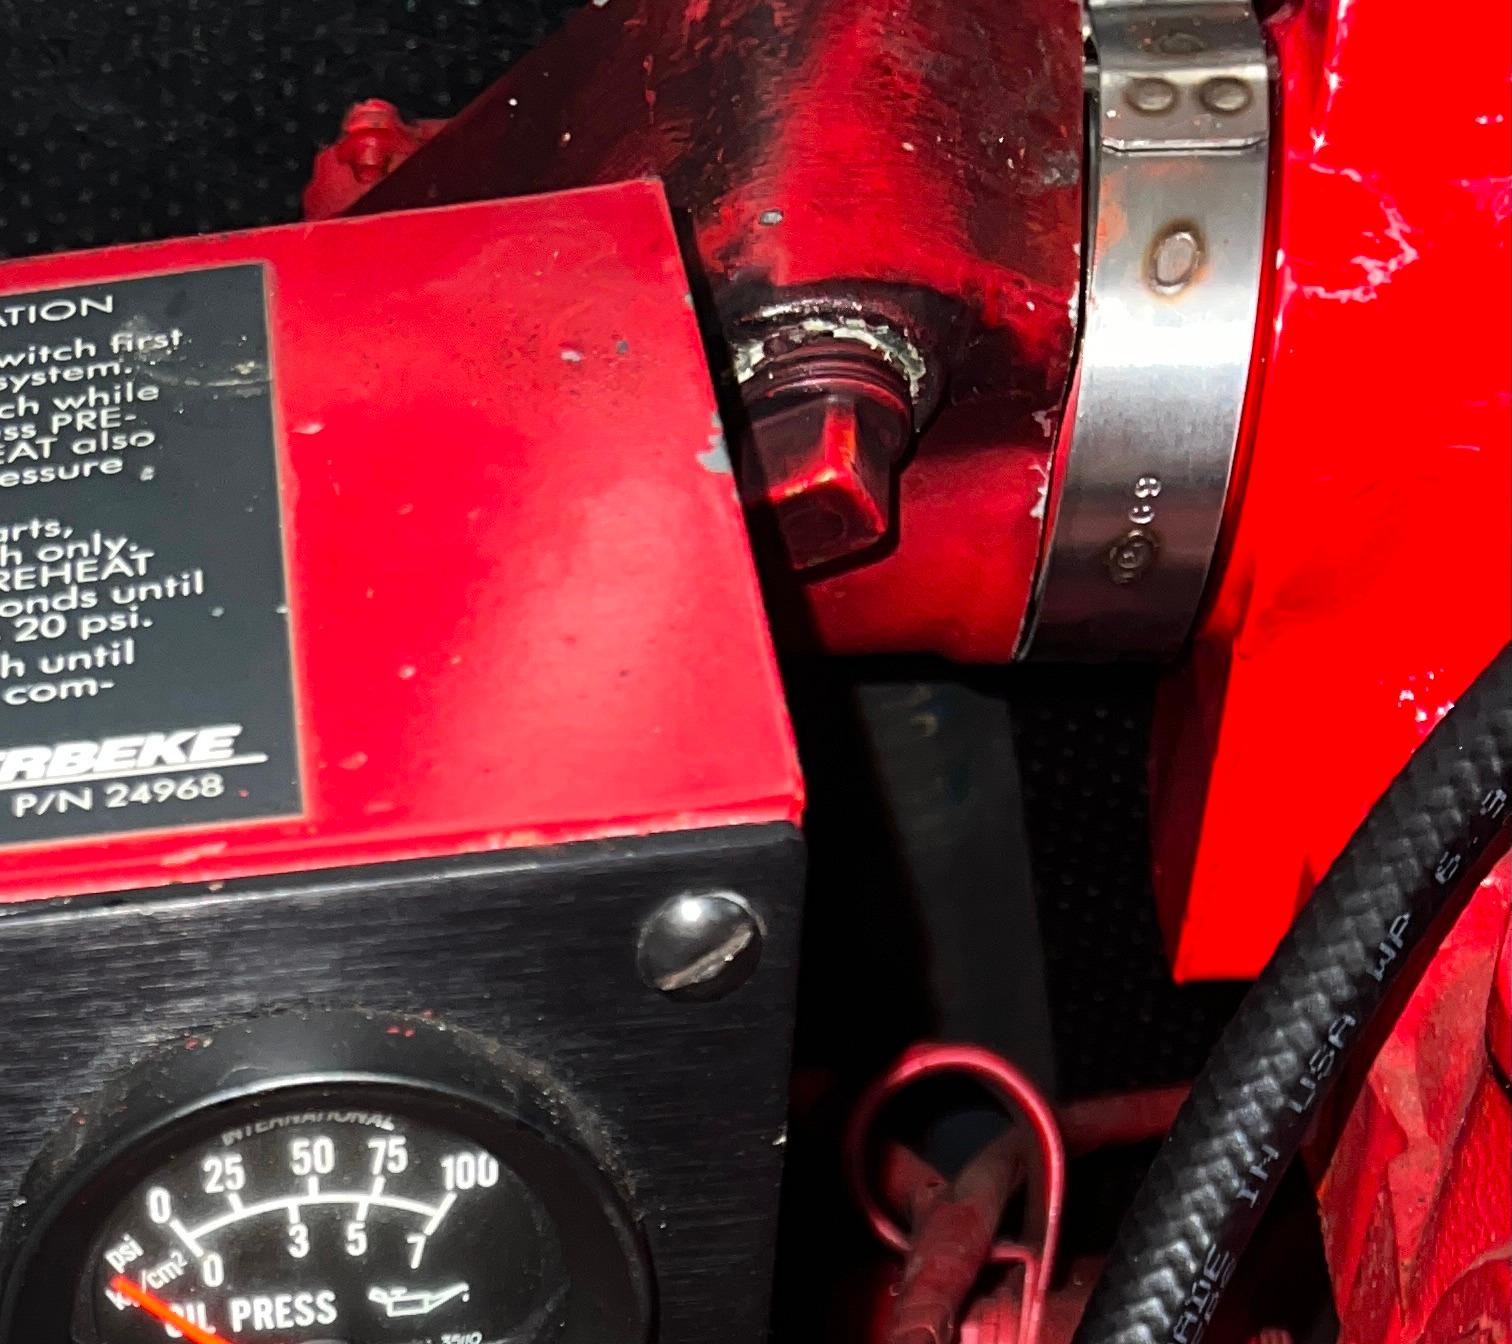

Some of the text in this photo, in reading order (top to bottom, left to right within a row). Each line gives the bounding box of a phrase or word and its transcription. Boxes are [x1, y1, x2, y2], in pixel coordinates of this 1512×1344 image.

[110, 328, 183, 354] first
[52, 381, 160, 410] while
[51, 408, 138, 435] PRE-
[72, 429, 157, 456] also
[36, 529, 139, 563] only.
[111, 568, 204, 604] until
[14, 613, 67, 643] 20
[80, 604, 153, 640] psi.
[38, 637, 135, 674] until
[2, 678, 115, 706] com-
[12, 773, 224, 818] P/N 24968
[1237, 1142, 1280, 1208] IN
[1287, 1013, 1358, 1116] USA
[1366, 912, 1412, 982] WP
[148, 1136, 499, 1223] 0 25 50 75 100
[105, 1233, 144, 1274] psi
[201, 1221, 427, 1288] 0 3 5 7
[231, 1290, 337, 1333] PRESS
